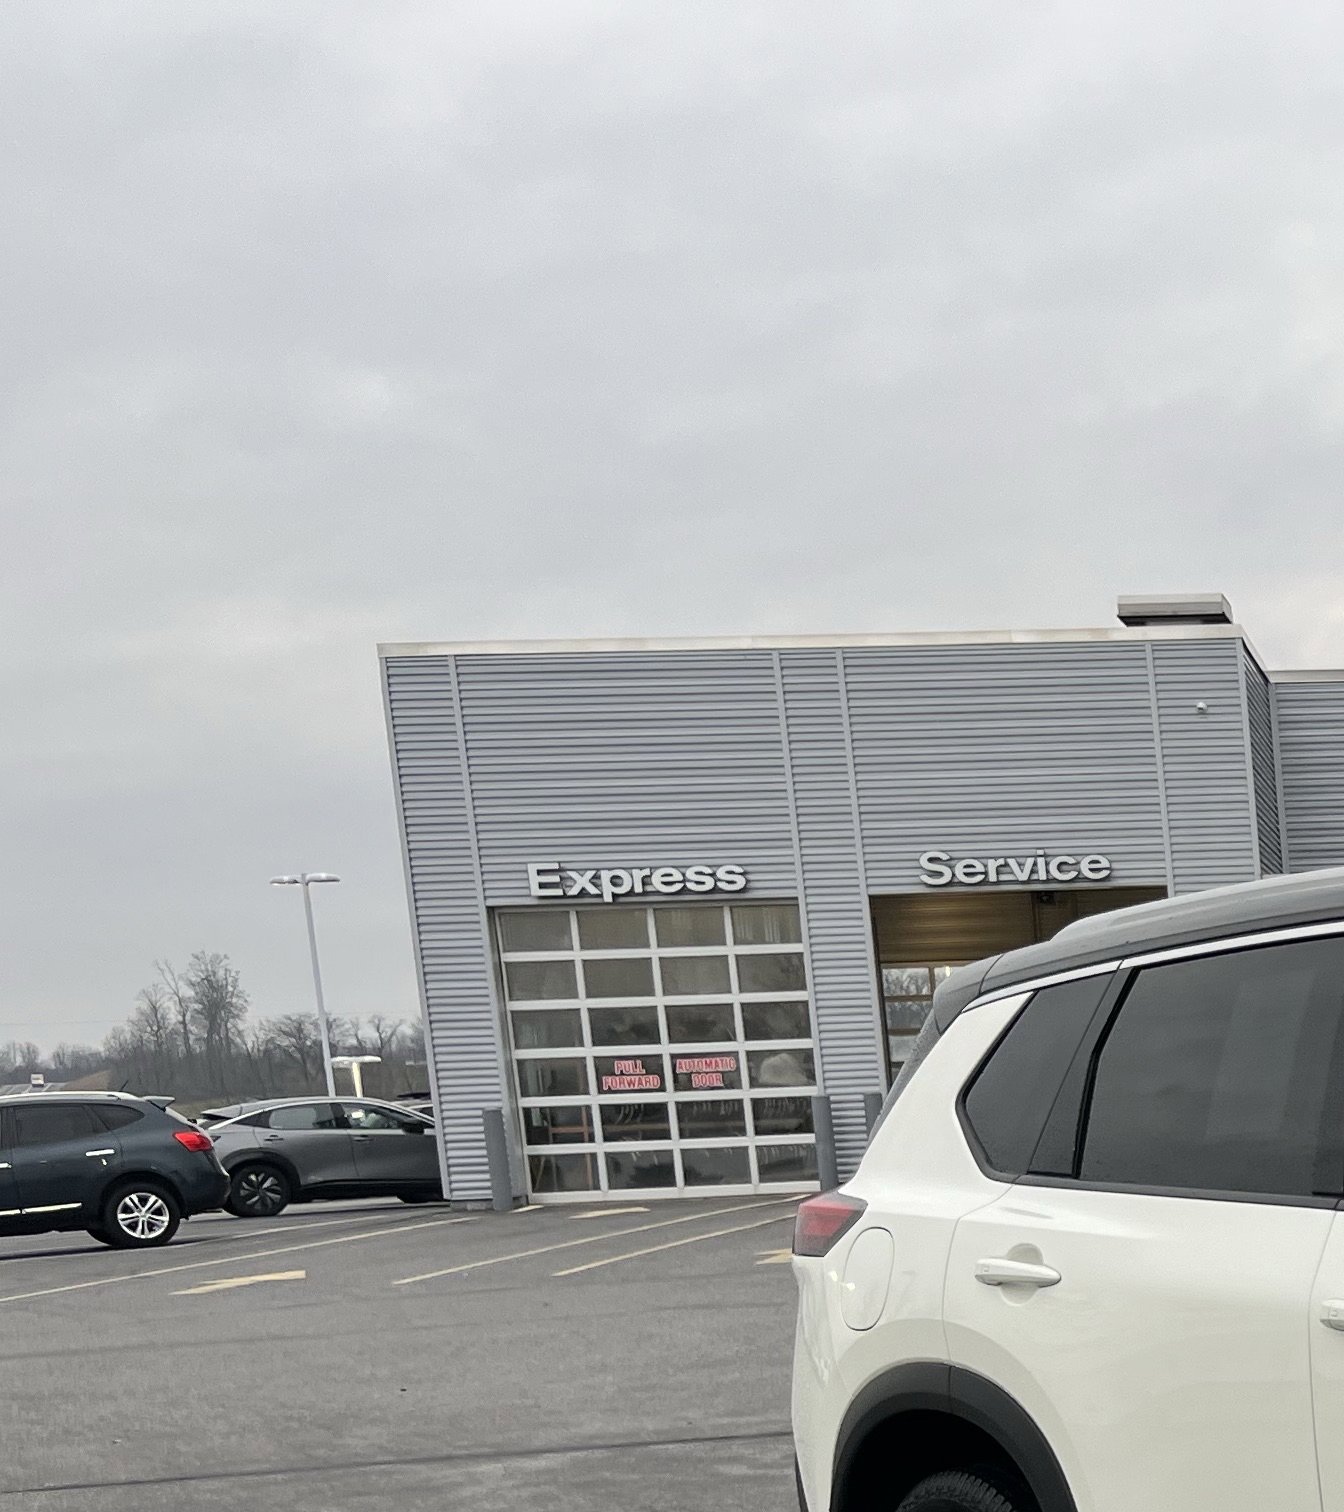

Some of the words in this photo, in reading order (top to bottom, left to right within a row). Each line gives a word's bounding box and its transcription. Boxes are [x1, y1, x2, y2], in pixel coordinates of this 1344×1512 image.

[919, 849, 1112, 886] Service
[527, 861, 747, 902] Express
[613, 1060, 646, 1074] PULL
[676, 1057, 737, 1073] AUTOMATIC
[602, 1075, 661, 1090] FORWARD
[691, 1072, 725, 1088] DOOR
